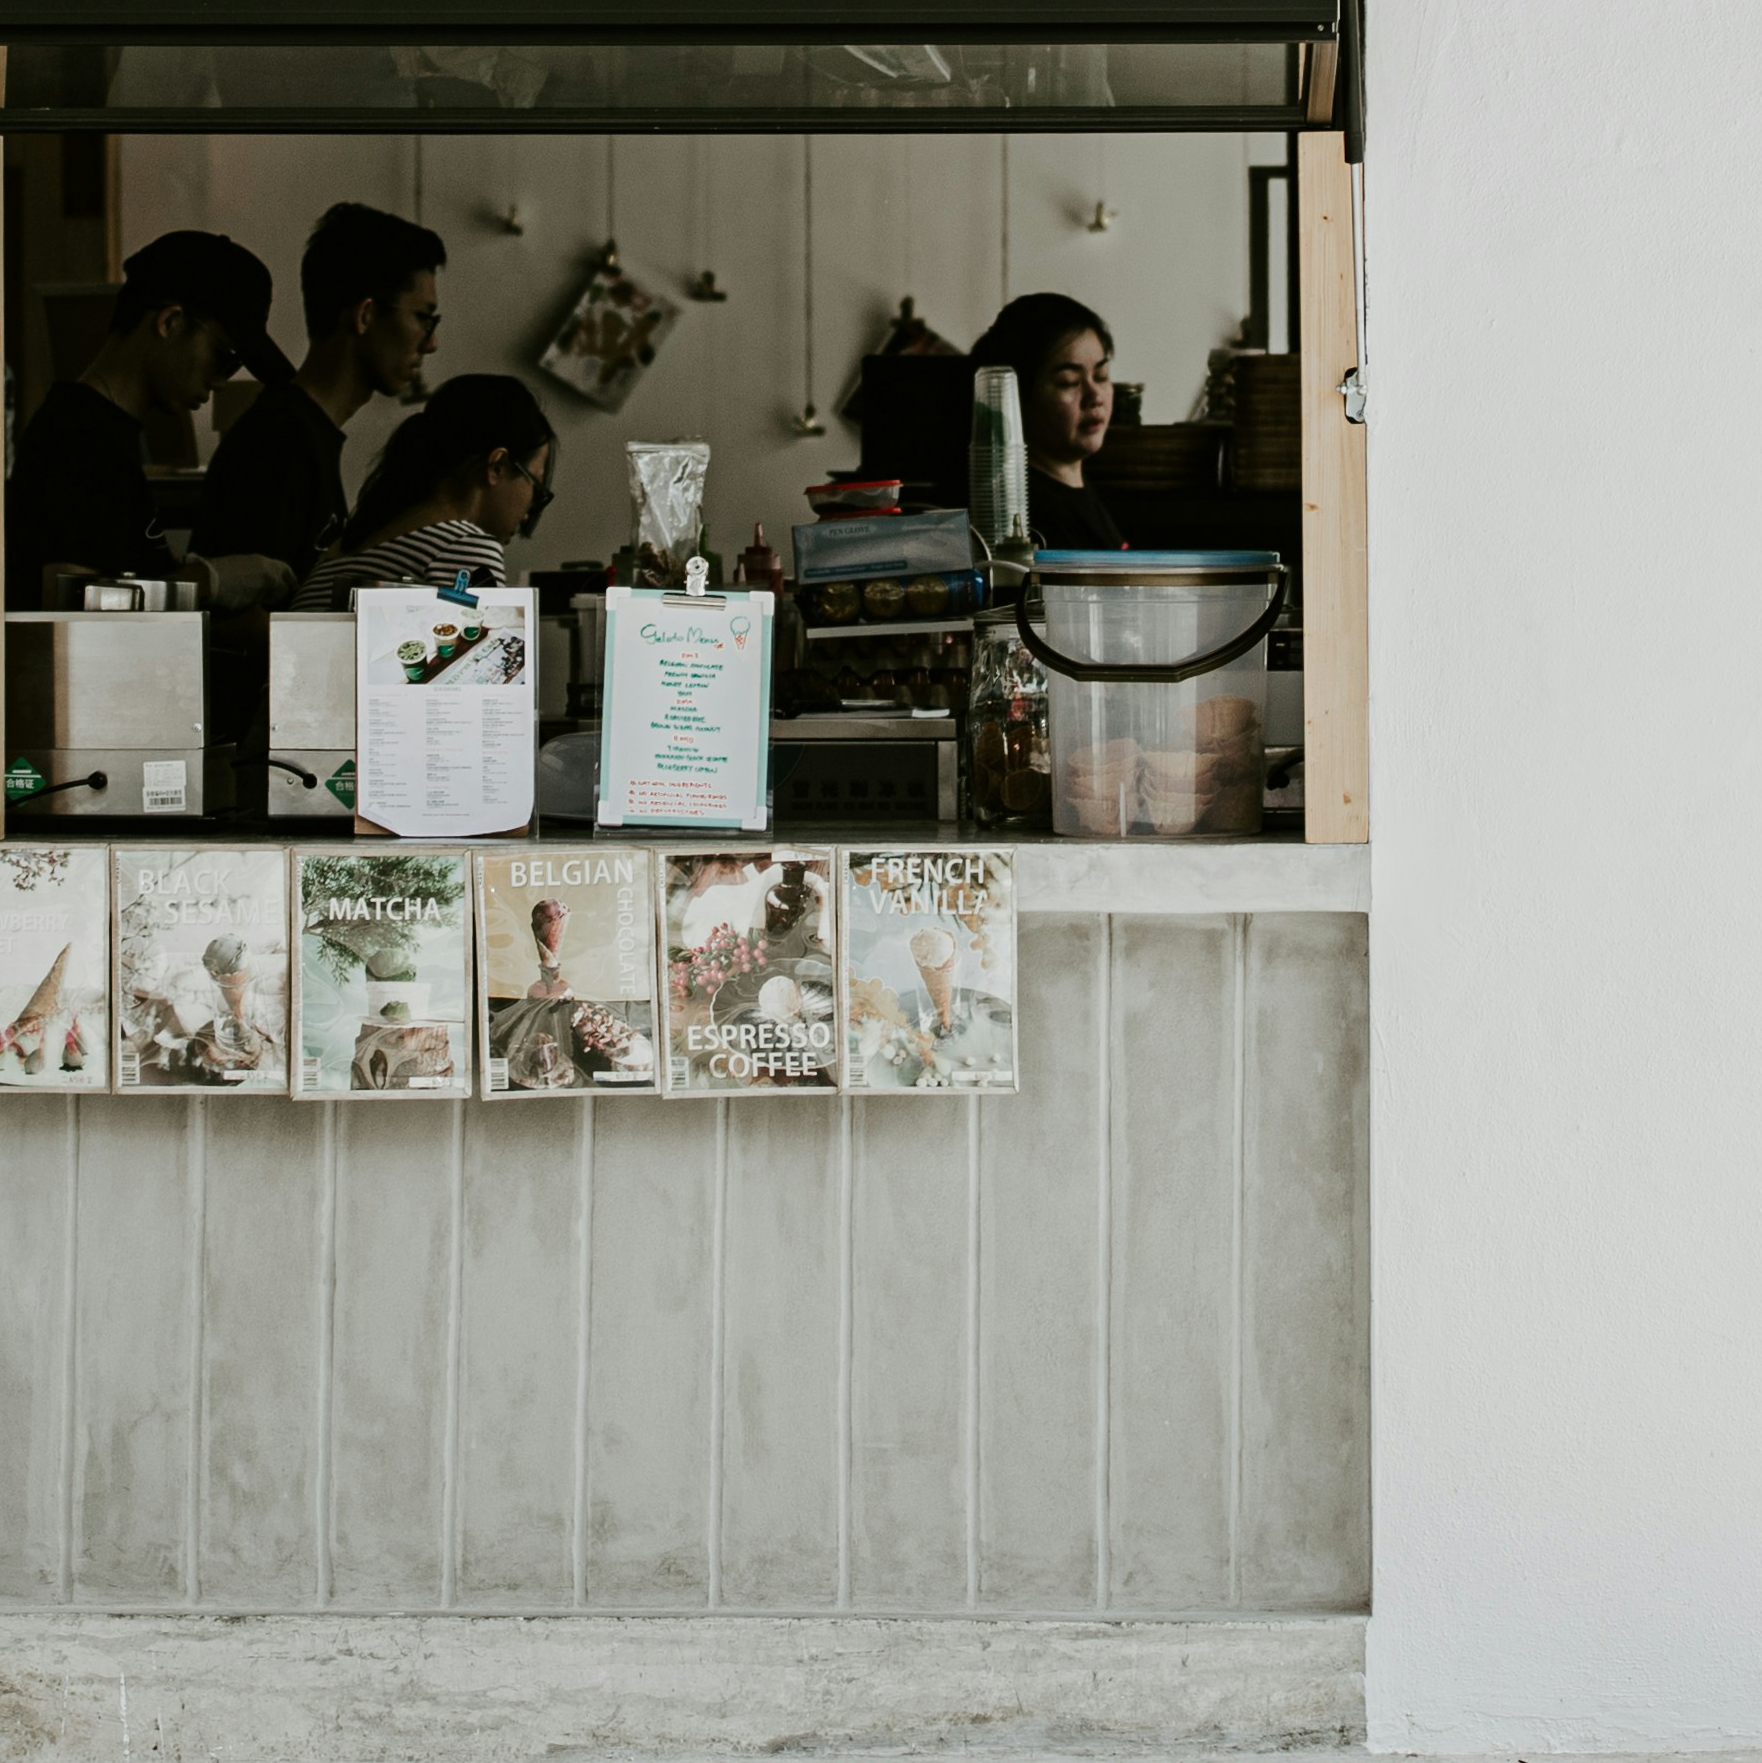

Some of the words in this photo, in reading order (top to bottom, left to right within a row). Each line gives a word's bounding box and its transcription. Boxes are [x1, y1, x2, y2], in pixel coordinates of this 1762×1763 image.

[138, 869, 232, 896] BLACK
[510, 858, 634, 888] BELGIAN
[870, 857, 985, 884] FRENCH
[163, 898, 282, 926] SESAME
[328, 896, 441, 921] MATCHA
[868, 889, 989, 915] VANILLA
[616, 888, 636, 995] CHOCOLATE
[688, 1022, 831, 1051] ESPRESSO
[709, 1052, 818, 1079] COFFEE
